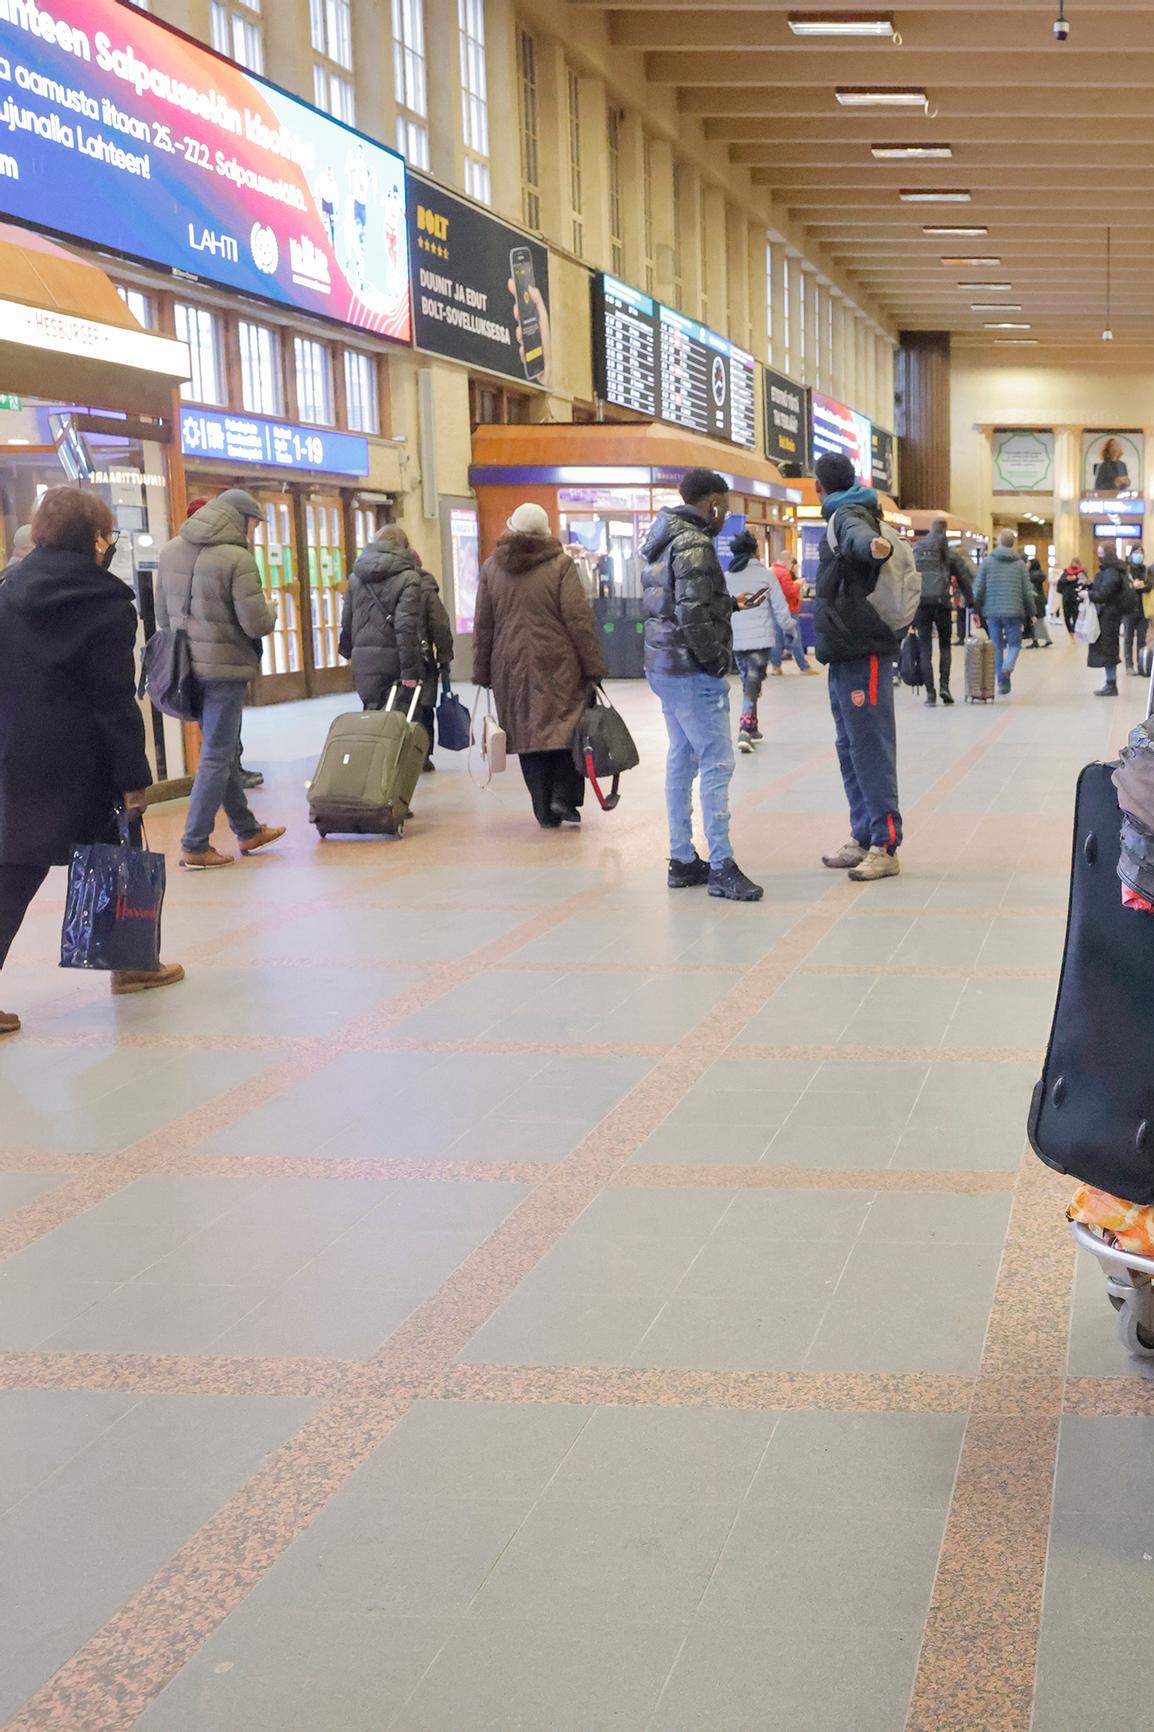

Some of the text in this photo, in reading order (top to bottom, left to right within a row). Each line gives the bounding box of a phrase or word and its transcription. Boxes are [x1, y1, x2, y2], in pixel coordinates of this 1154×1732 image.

[15, 64, 100, 121] aamusta
[101, 97, 151, 143] iltaan
[77, 125, 151, 180] Lahteen!
[417, 204, 449, 241] BOLT
[420, 268, 488, 312] DUUNIT JA EDUT
[421, 296, 511, 345] BOLT-SOVELLUKSESSA
[292, 433, 324, 464] 1-19
